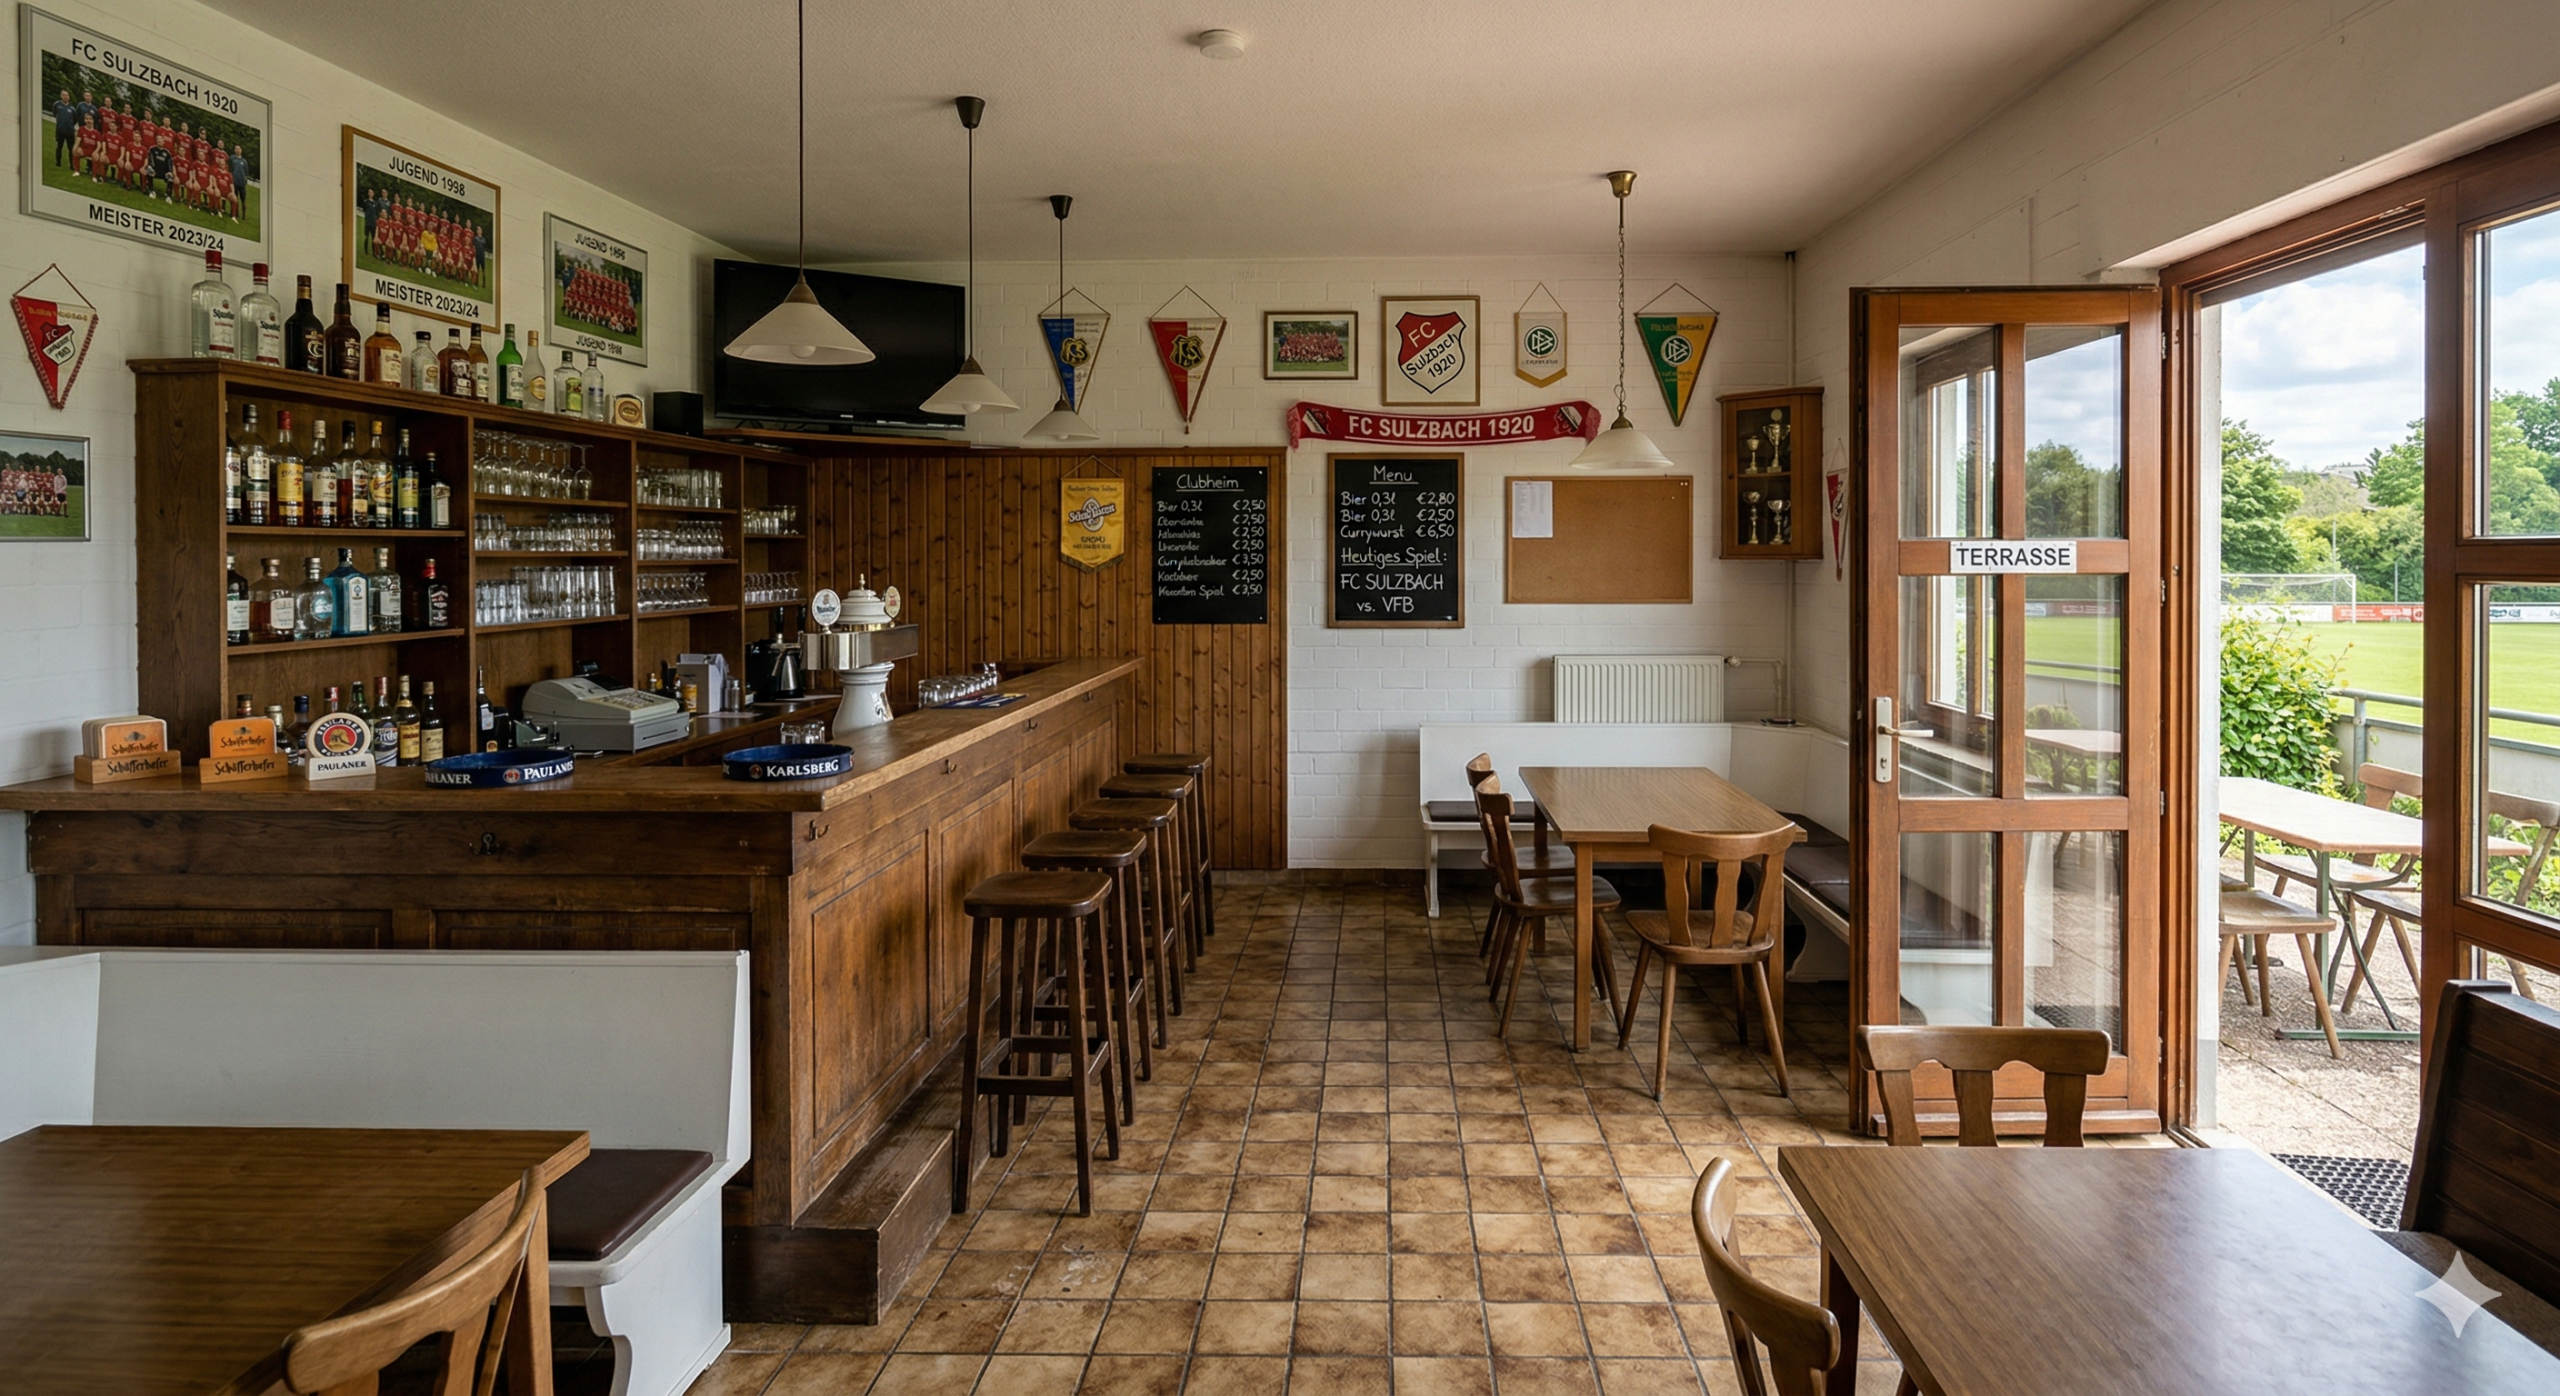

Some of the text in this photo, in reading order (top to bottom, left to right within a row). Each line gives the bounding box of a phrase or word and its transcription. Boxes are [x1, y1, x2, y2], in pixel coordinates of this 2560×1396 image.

[72, 38, 238, 115] FC SULZBACH 1920
[388, 156, 466, 197] JUGEND 1998
[89, 203, 225, 251] MEISTER 2023/24
[375, 278, 480, 318] MEISTER 2023/24
[1407, 321, 1436, 348] FC
[1427, 353, 1456, 378] 1920
[1348, 414, 1535, 439] FC SULZBACH 1920
[1176, 474, 1239, 489] Clubheim
[1373, 465, 1413, 482] Menu
[1340, 491, 1367, 506] Bier
[1340, 508, 1366, 522] Bier
[1415, 508, 1455, 524] €2,50
[1340, 524, 1455, 544] Currywurst €6,50
[1341, 547, 1401, 569] Heutiges
[1956, 548, 2071, 566] TERRASSE
[1340, 573, 1444, 590] FC SULZBACH
[1356, 596, 1415, 613] vs. VFB
[317, 761, 367, 772] PAULANER
[766, 759, 839, 777] KARLSBERG
